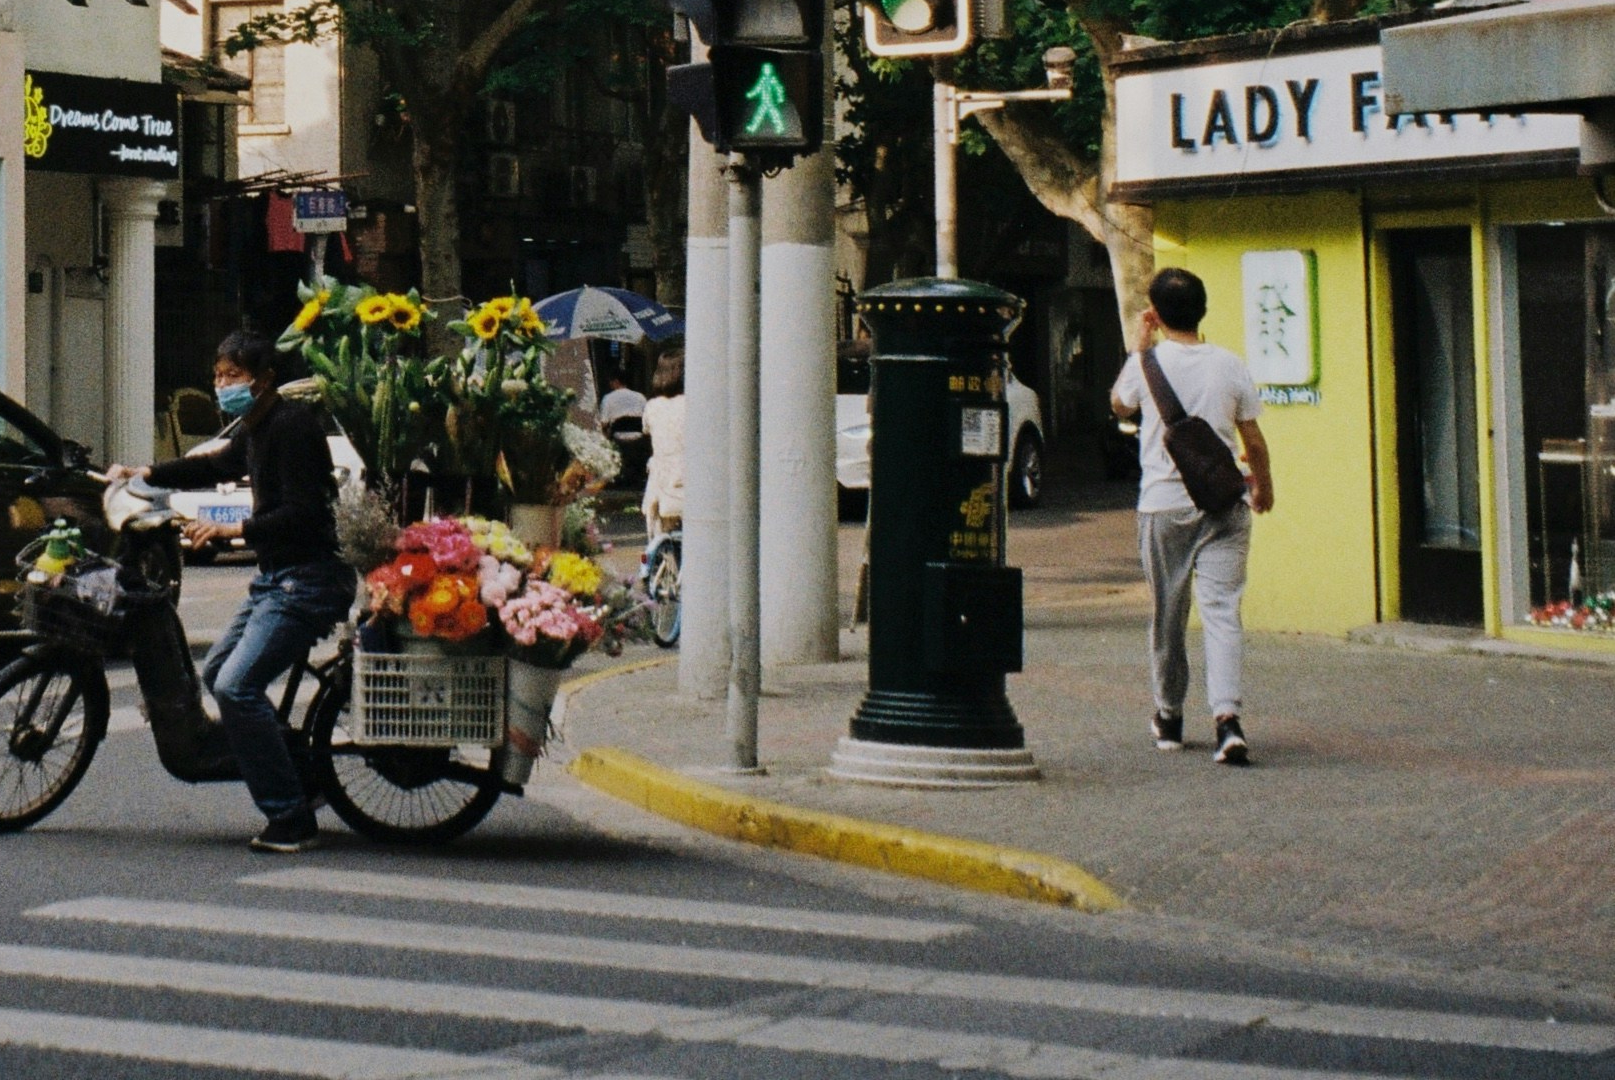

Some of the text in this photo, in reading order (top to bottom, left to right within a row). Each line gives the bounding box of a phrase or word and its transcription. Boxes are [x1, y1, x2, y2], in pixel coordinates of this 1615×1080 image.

[49, 104, 174, 137] Dreams Come True
[1170, 78, 1322, 150] LADY
